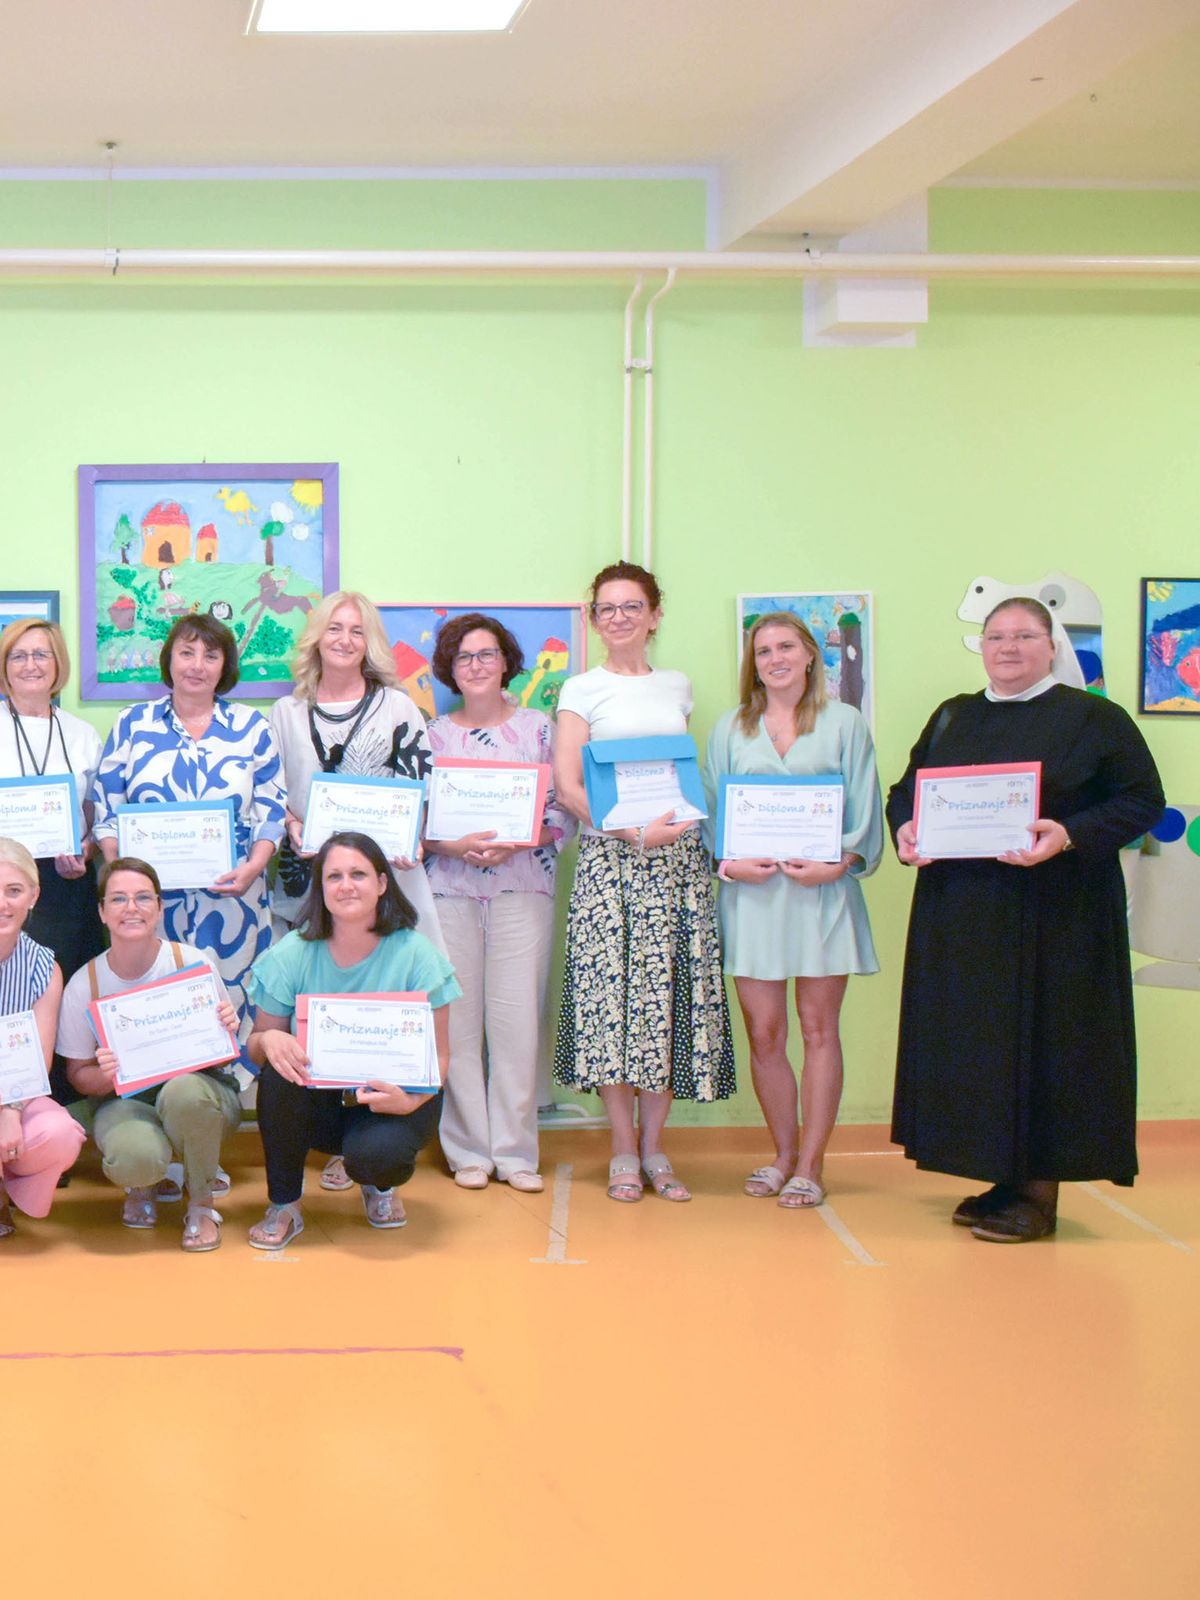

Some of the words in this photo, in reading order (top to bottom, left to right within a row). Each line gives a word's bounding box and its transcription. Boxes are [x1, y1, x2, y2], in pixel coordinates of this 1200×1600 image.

[457, 788, 509, 803] Priznanje
[335, 803, 388, 819] Priznanje
[758, 802, 805, 815] Diploma
[948, 797, 1008, 813] Priznanje
[152, 830, 196, 842] Diploma
[133, 1004, 192, 1027] Priznanje
[339, 1023, 399, 1039] Priznanje
